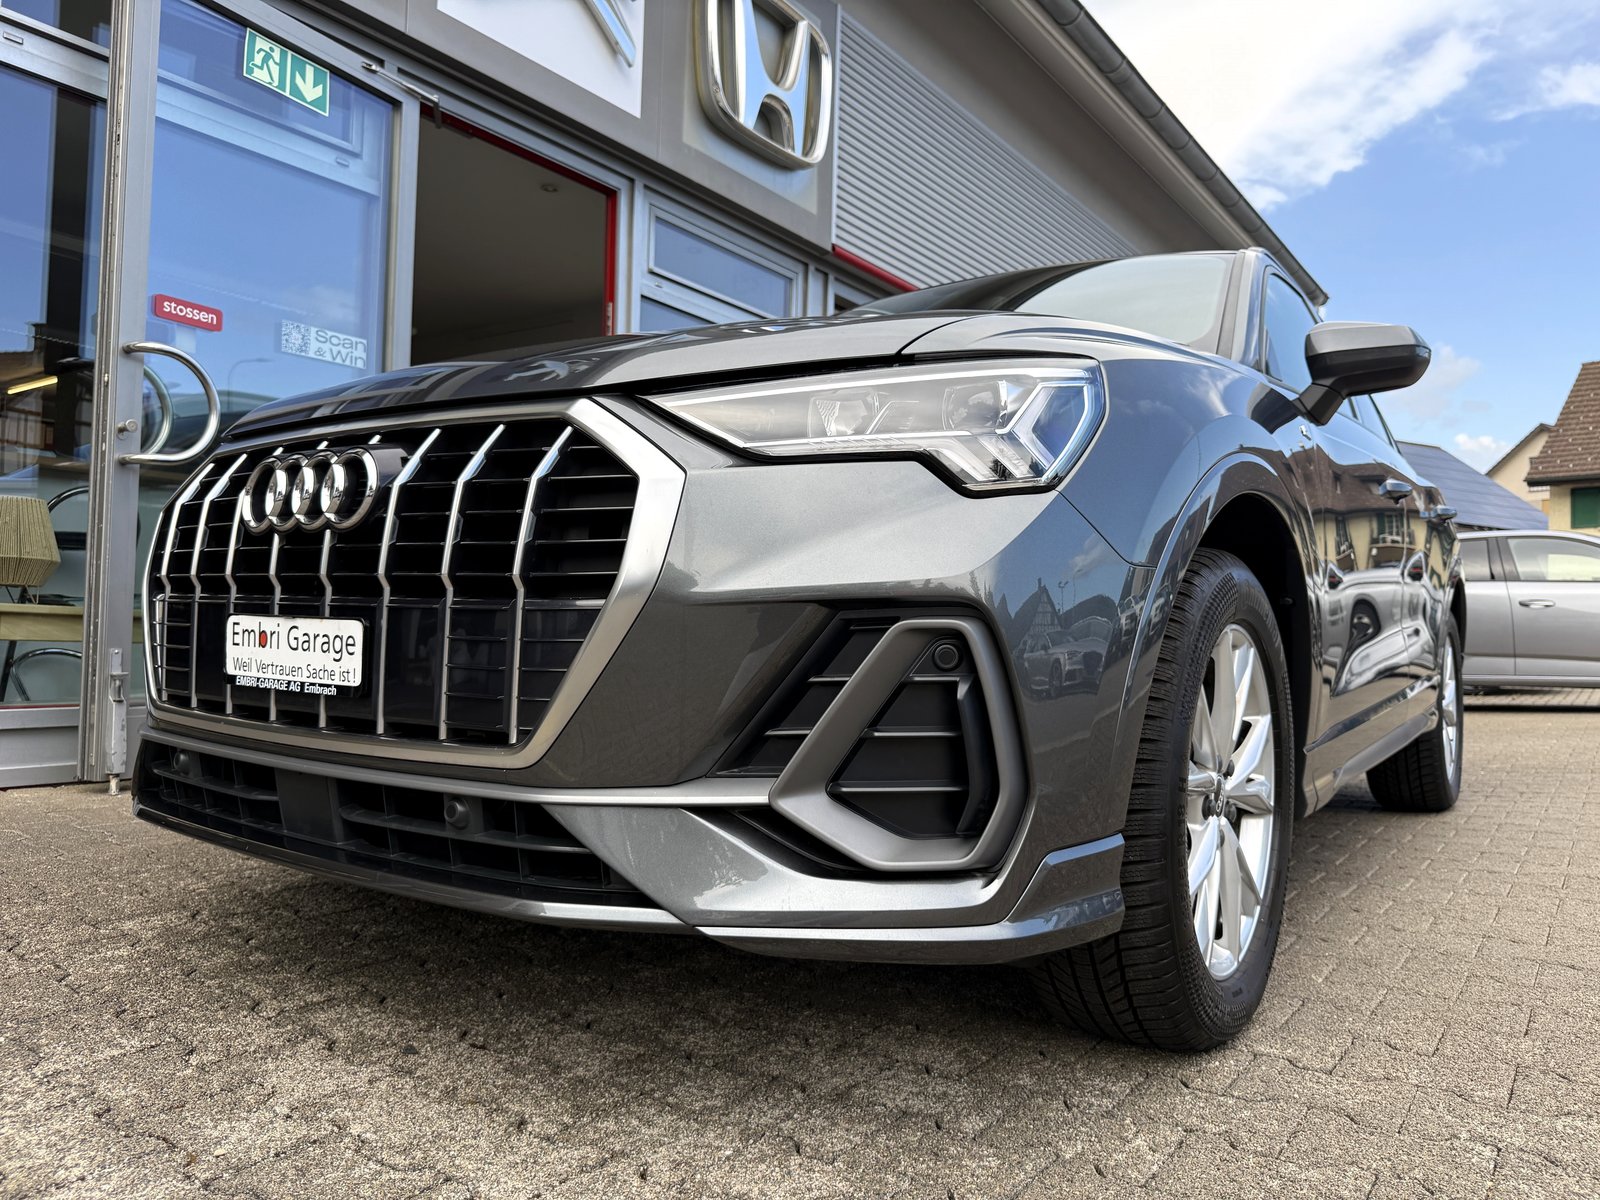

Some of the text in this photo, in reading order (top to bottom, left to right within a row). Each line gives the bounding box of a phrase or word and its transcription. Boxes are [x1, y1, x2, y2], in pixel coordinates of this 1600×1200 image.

[163, 300, 217, 325] stossen
[315, 330, 367, 353] Scan
[314, 347, 366, 368] & Win
[232, 621, 356, 662] Embri Garage
[233, 657, 252, 673] Weil
[255, 659, 303, 678] Vertrauen
[306, 664, 336, 682] Sache
[235, 675, 337, 696] EMBRI-GARAGE AG Embrach
